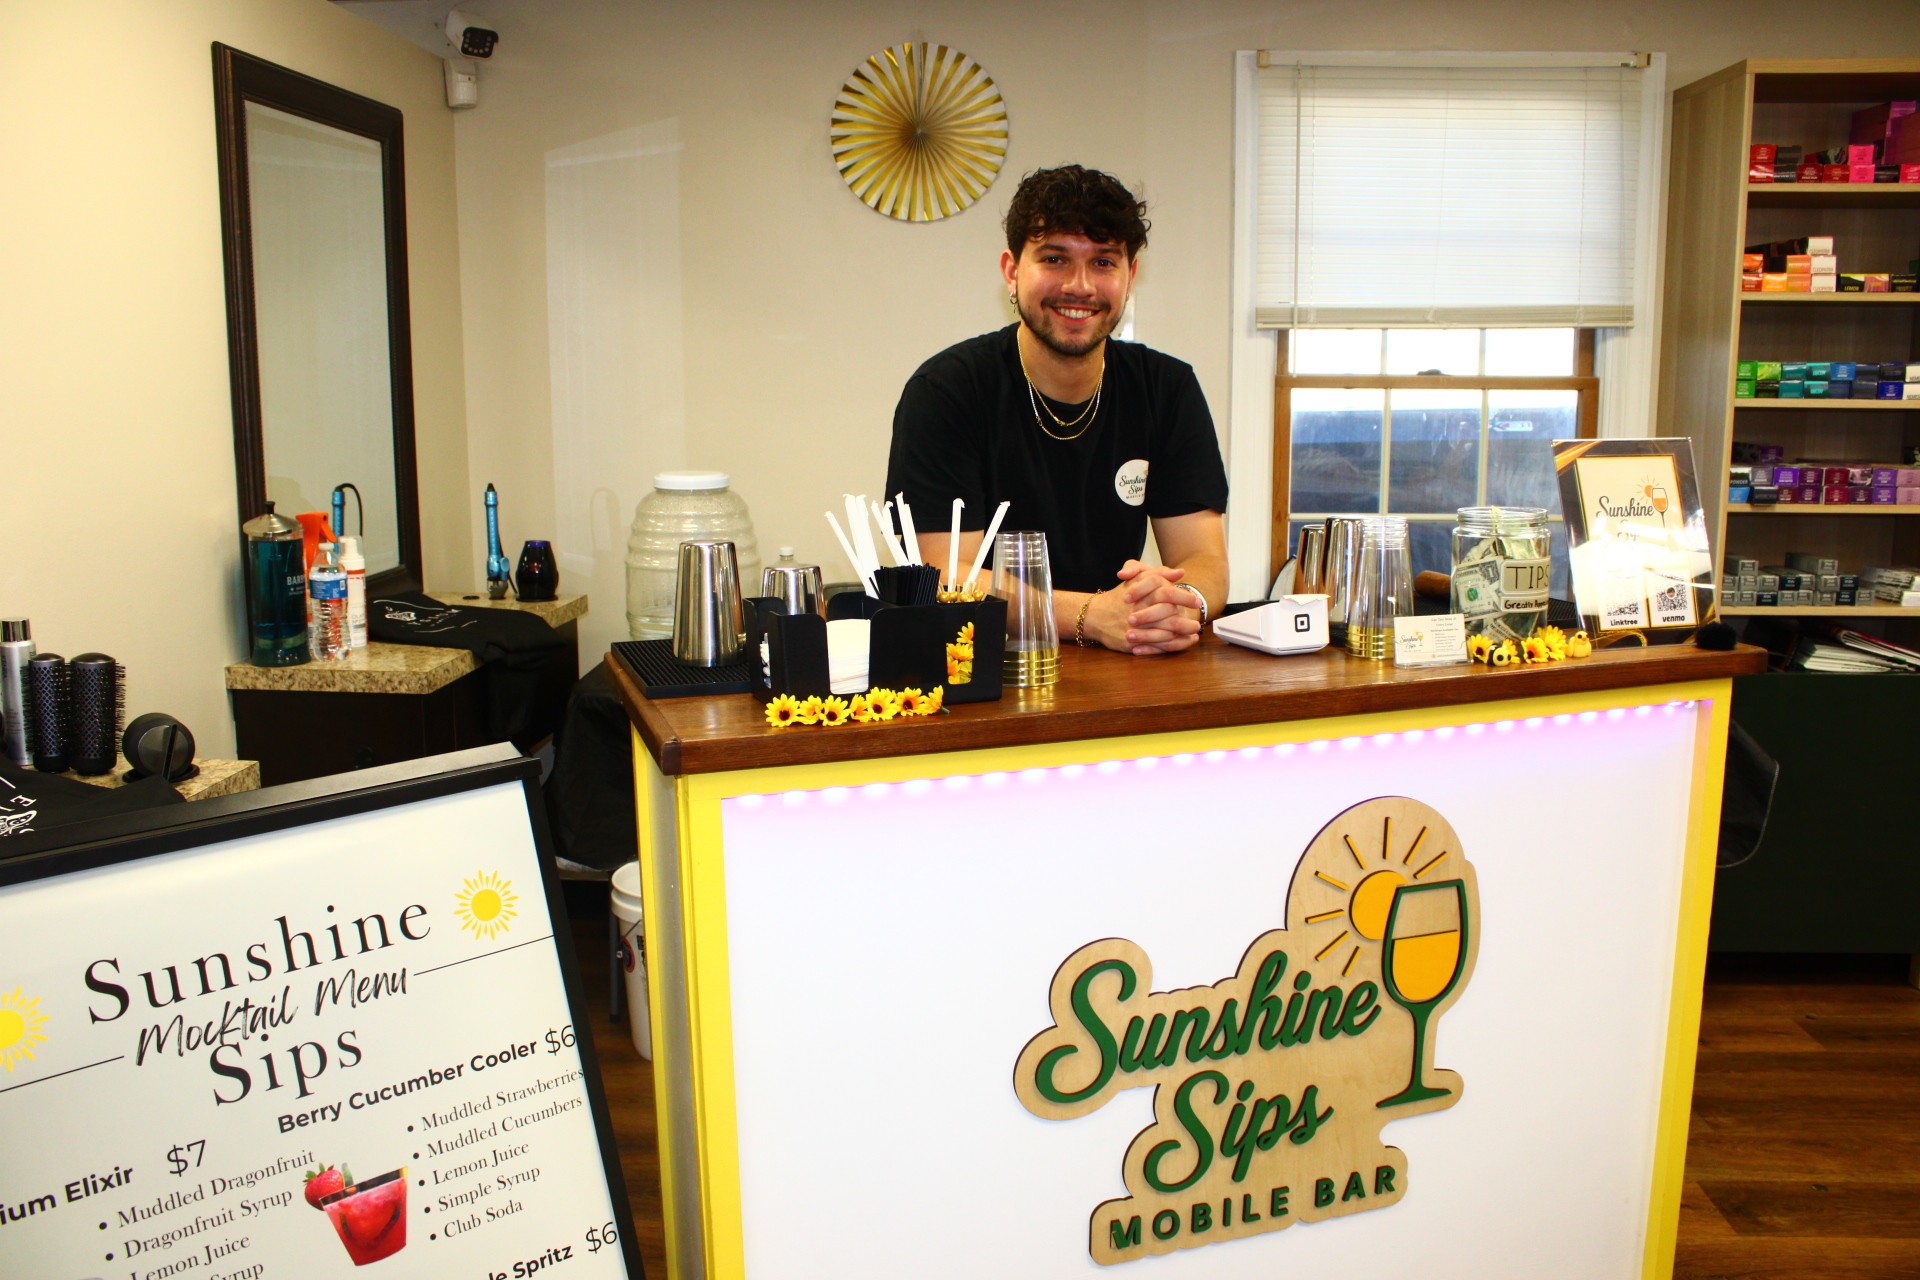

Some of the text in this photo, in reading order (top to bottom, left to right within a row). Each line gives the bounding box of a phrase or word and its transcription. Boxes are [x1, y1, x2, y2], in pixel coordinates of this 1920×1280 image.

[1128, 485, 1143, 494] Sips
[1596, 495, 1655, 519] Sunshine
[1505, 564, 1550, 590] TIPS
[1610, 619, 1638, 627] Linktree
[84, 903, 432, 1025] Sunshine
[134, 967, 409, 1067] Mocktail Menu
[1034, 950, 1382, 1105] Sunshine
[208, 1029, 364, 1107] Sips
[277, 1025, 576, 1135] Berry Cucumber Cooler $6
[421, 1067, 585, 1132] Muddled Strawberries
[427, 1095, 583, 1159] Muddled Cucumbers
[166, 1139, 206, 1177] $7
[1143, 1069, 1335, 1194] Sips
[64, 1165, 134, 1203] Elixir
[117, 1149, 316, 1229] Muddled Dragonfruit
[432, 1143, 530, 1187] Lemon Juice
[438, 1166, 541, 1213] Simple Syrup
[123, 1188, 293, 1260] Dragonfruit Syrup
[443, 1199, 524, 1239] Club Soda
[1109, 1164, 1397, 1251] MOBILE BAR
[130, 1235, 251, 1280] Lemon Juice
[512, 1244, 574, 1280] Spritz
[585, 1221, 618, 1254] $6
